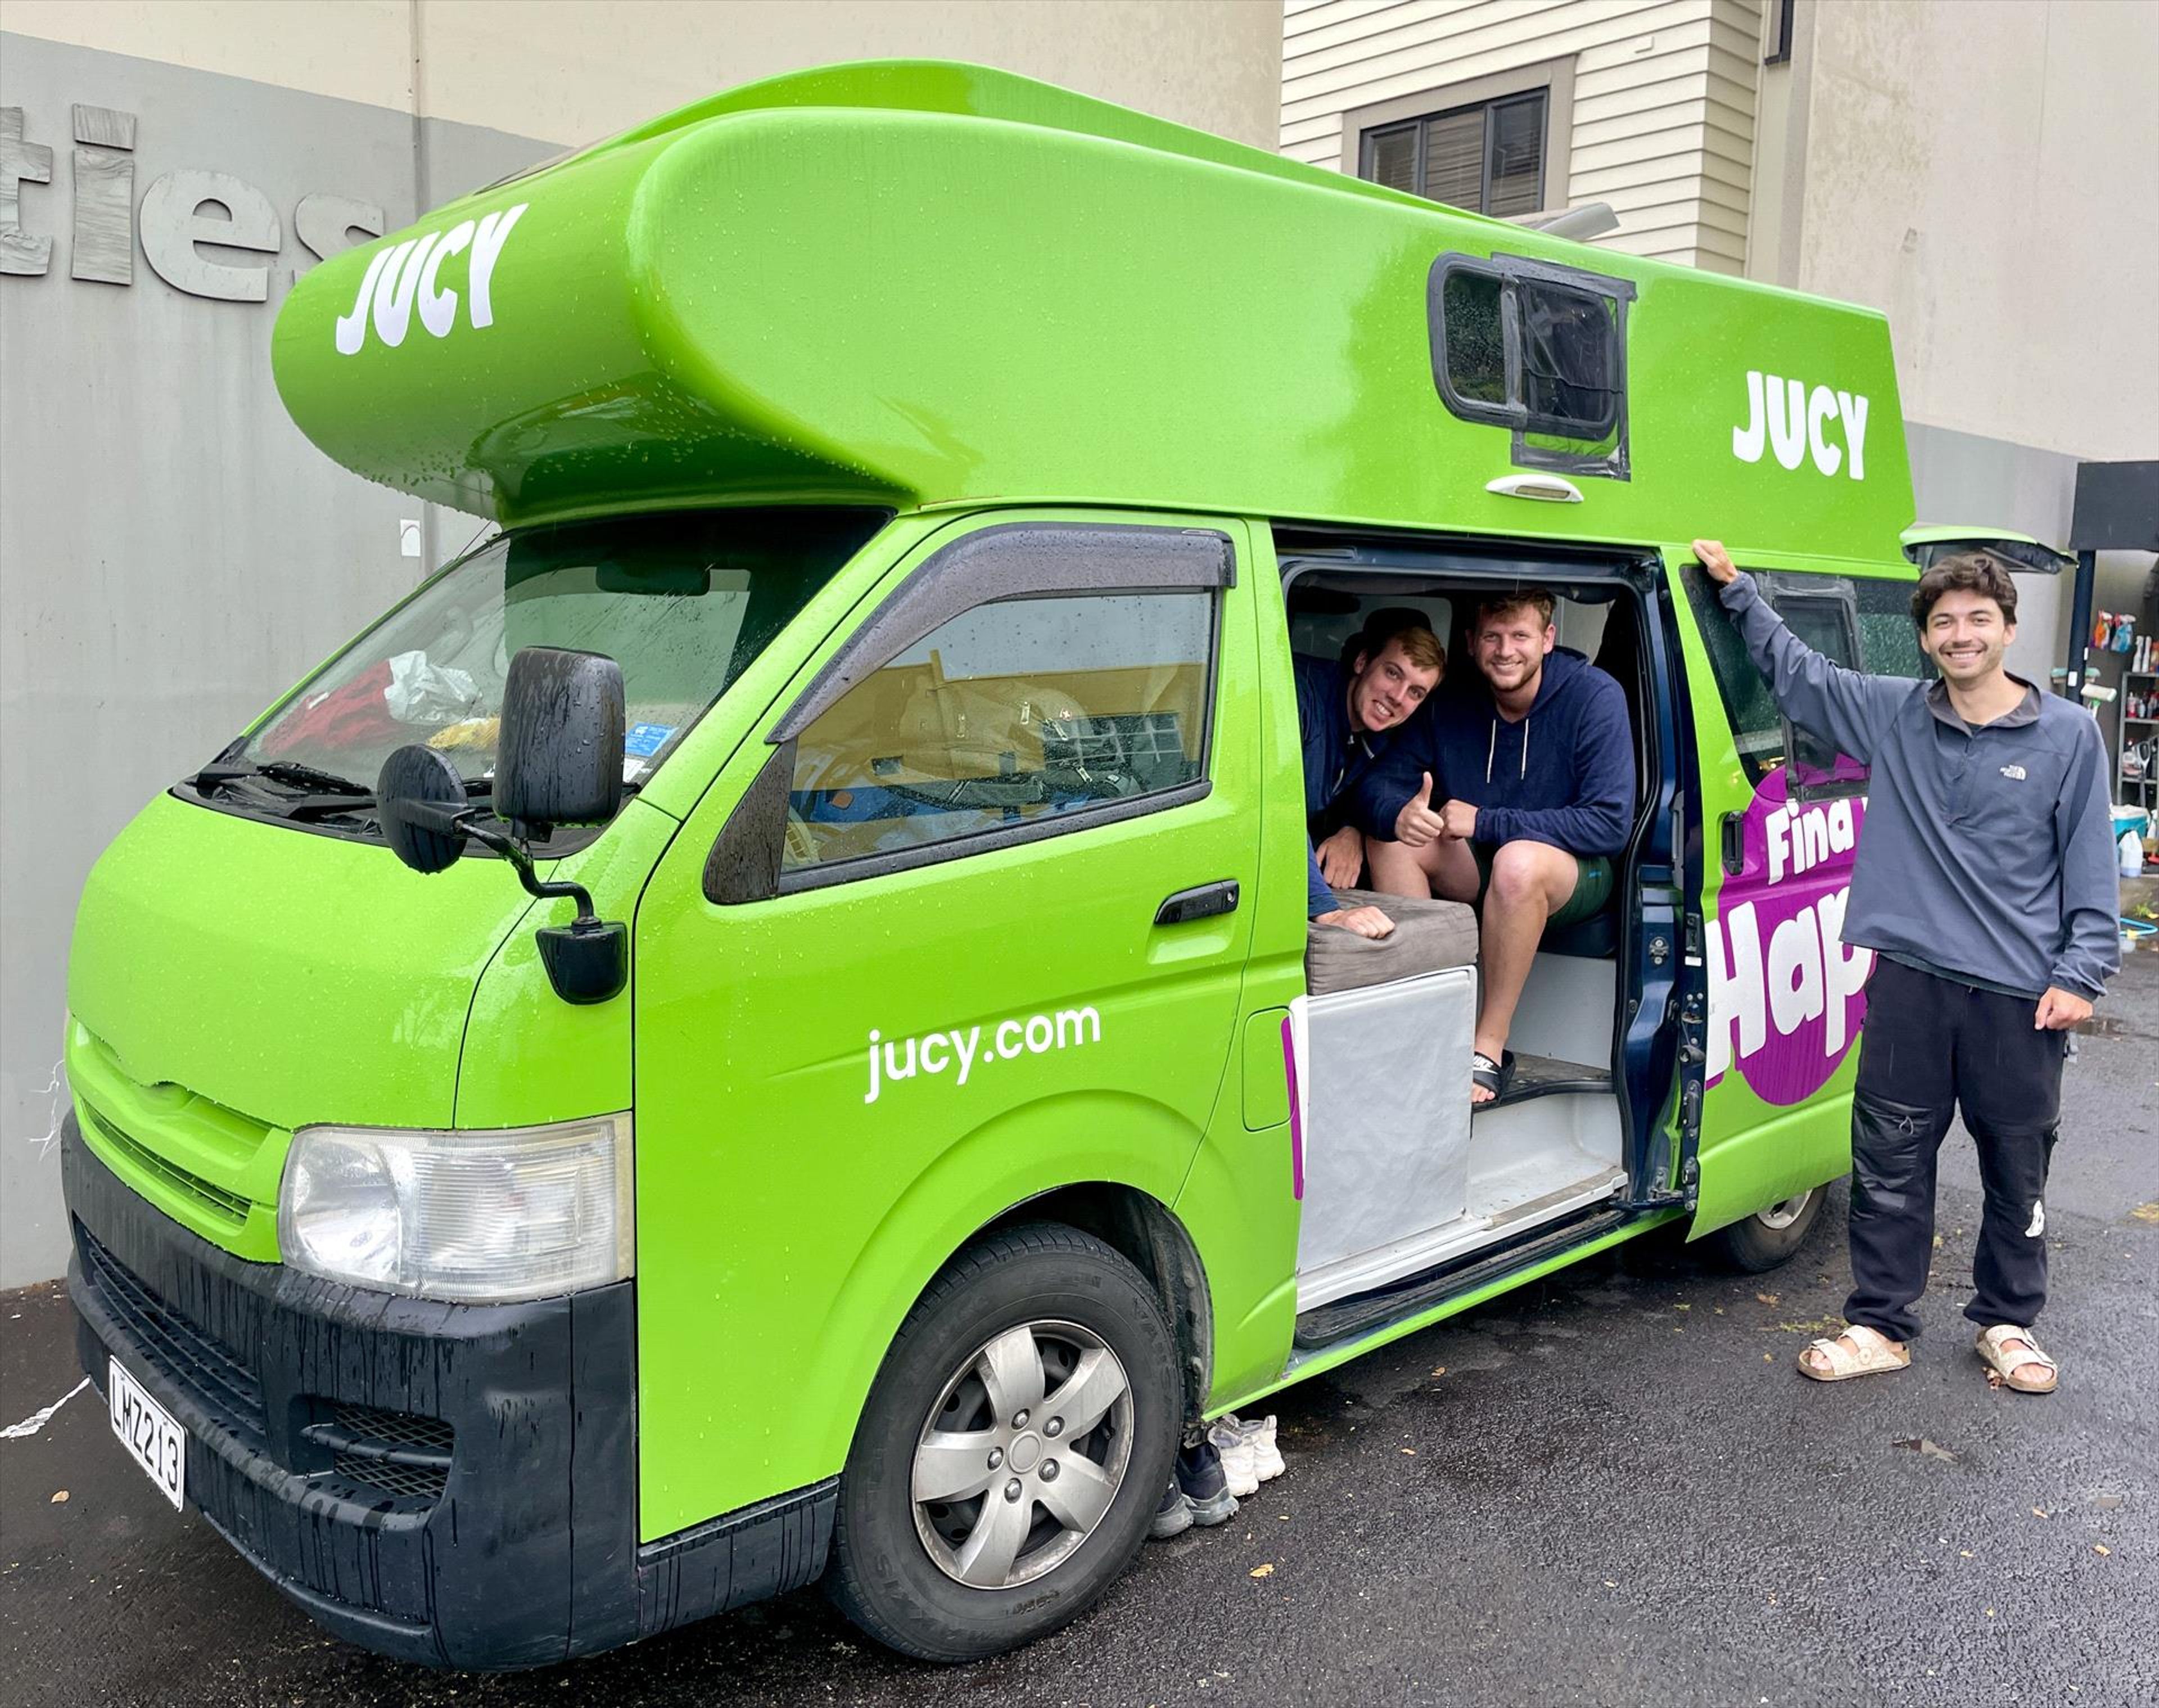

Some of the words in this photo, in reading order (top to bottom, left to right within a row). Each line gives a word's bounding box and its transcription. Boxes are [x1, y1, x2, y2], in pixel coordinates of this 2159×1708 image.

[336, 202, 530, 355] JUCY
[1732, 369, 1869, 481] JUCY
[864, 1006, 1101, 1104] jucy.com
[112, 1372, 178, 1493] LMZ213
